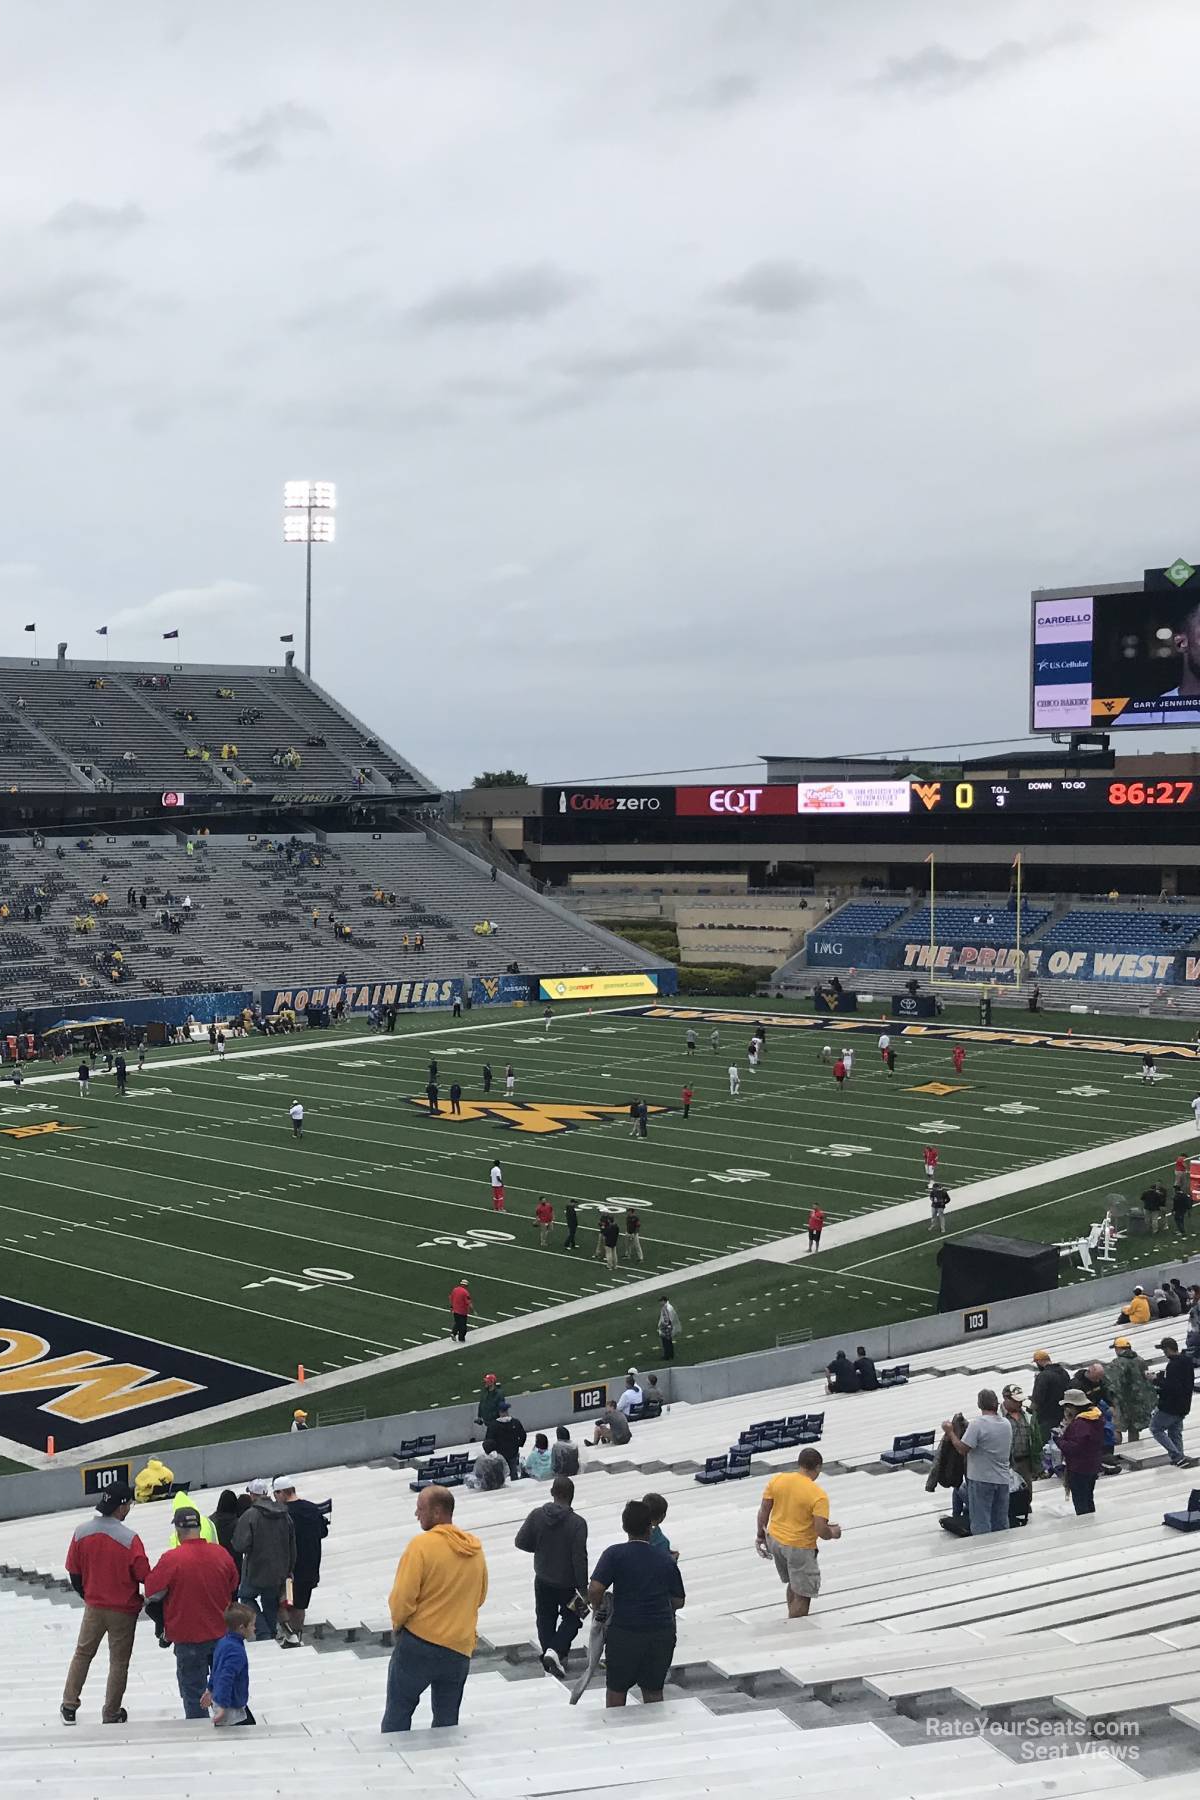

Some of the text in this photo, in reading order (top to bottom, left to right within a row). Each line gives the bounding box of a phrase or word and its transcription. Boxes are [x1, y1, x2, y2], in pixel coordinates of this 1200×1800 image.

[1038, 614, 1091, 625] CARDELLO
[1060, 698, 1089, 707] BAKERY
[1028, 782, 1051, 790] DOWN
[1073, 781, 1085, 789] GO
[1108, 783, 1193, 804] 86:27
[570, 793, 659, 810] Coke zero
[710, 789, 762, 813] EQT
[956, 783, 973, 808] 0
[996, 796, 1004, 806] 3
[814, 943, 842, 955] IMG
[904, 945, 953, 967] THE
[958, 947, 1041, 971] PRIDE
[1048, 952, 1087, 974] OF
[1093, 953, 1175, 979] WEST
[274, 981, 453, 1013] MOUNTAINEERS
[707, 1169, 771, 1183] 40
[432, 1229, 516, 1250] 20
[261, 1268, 355, 1292] 10
[969, 1314, 984, 1329] 103
[580, 1390, 600, 1407] 102
[96, 1470, 118, 1489] 101
